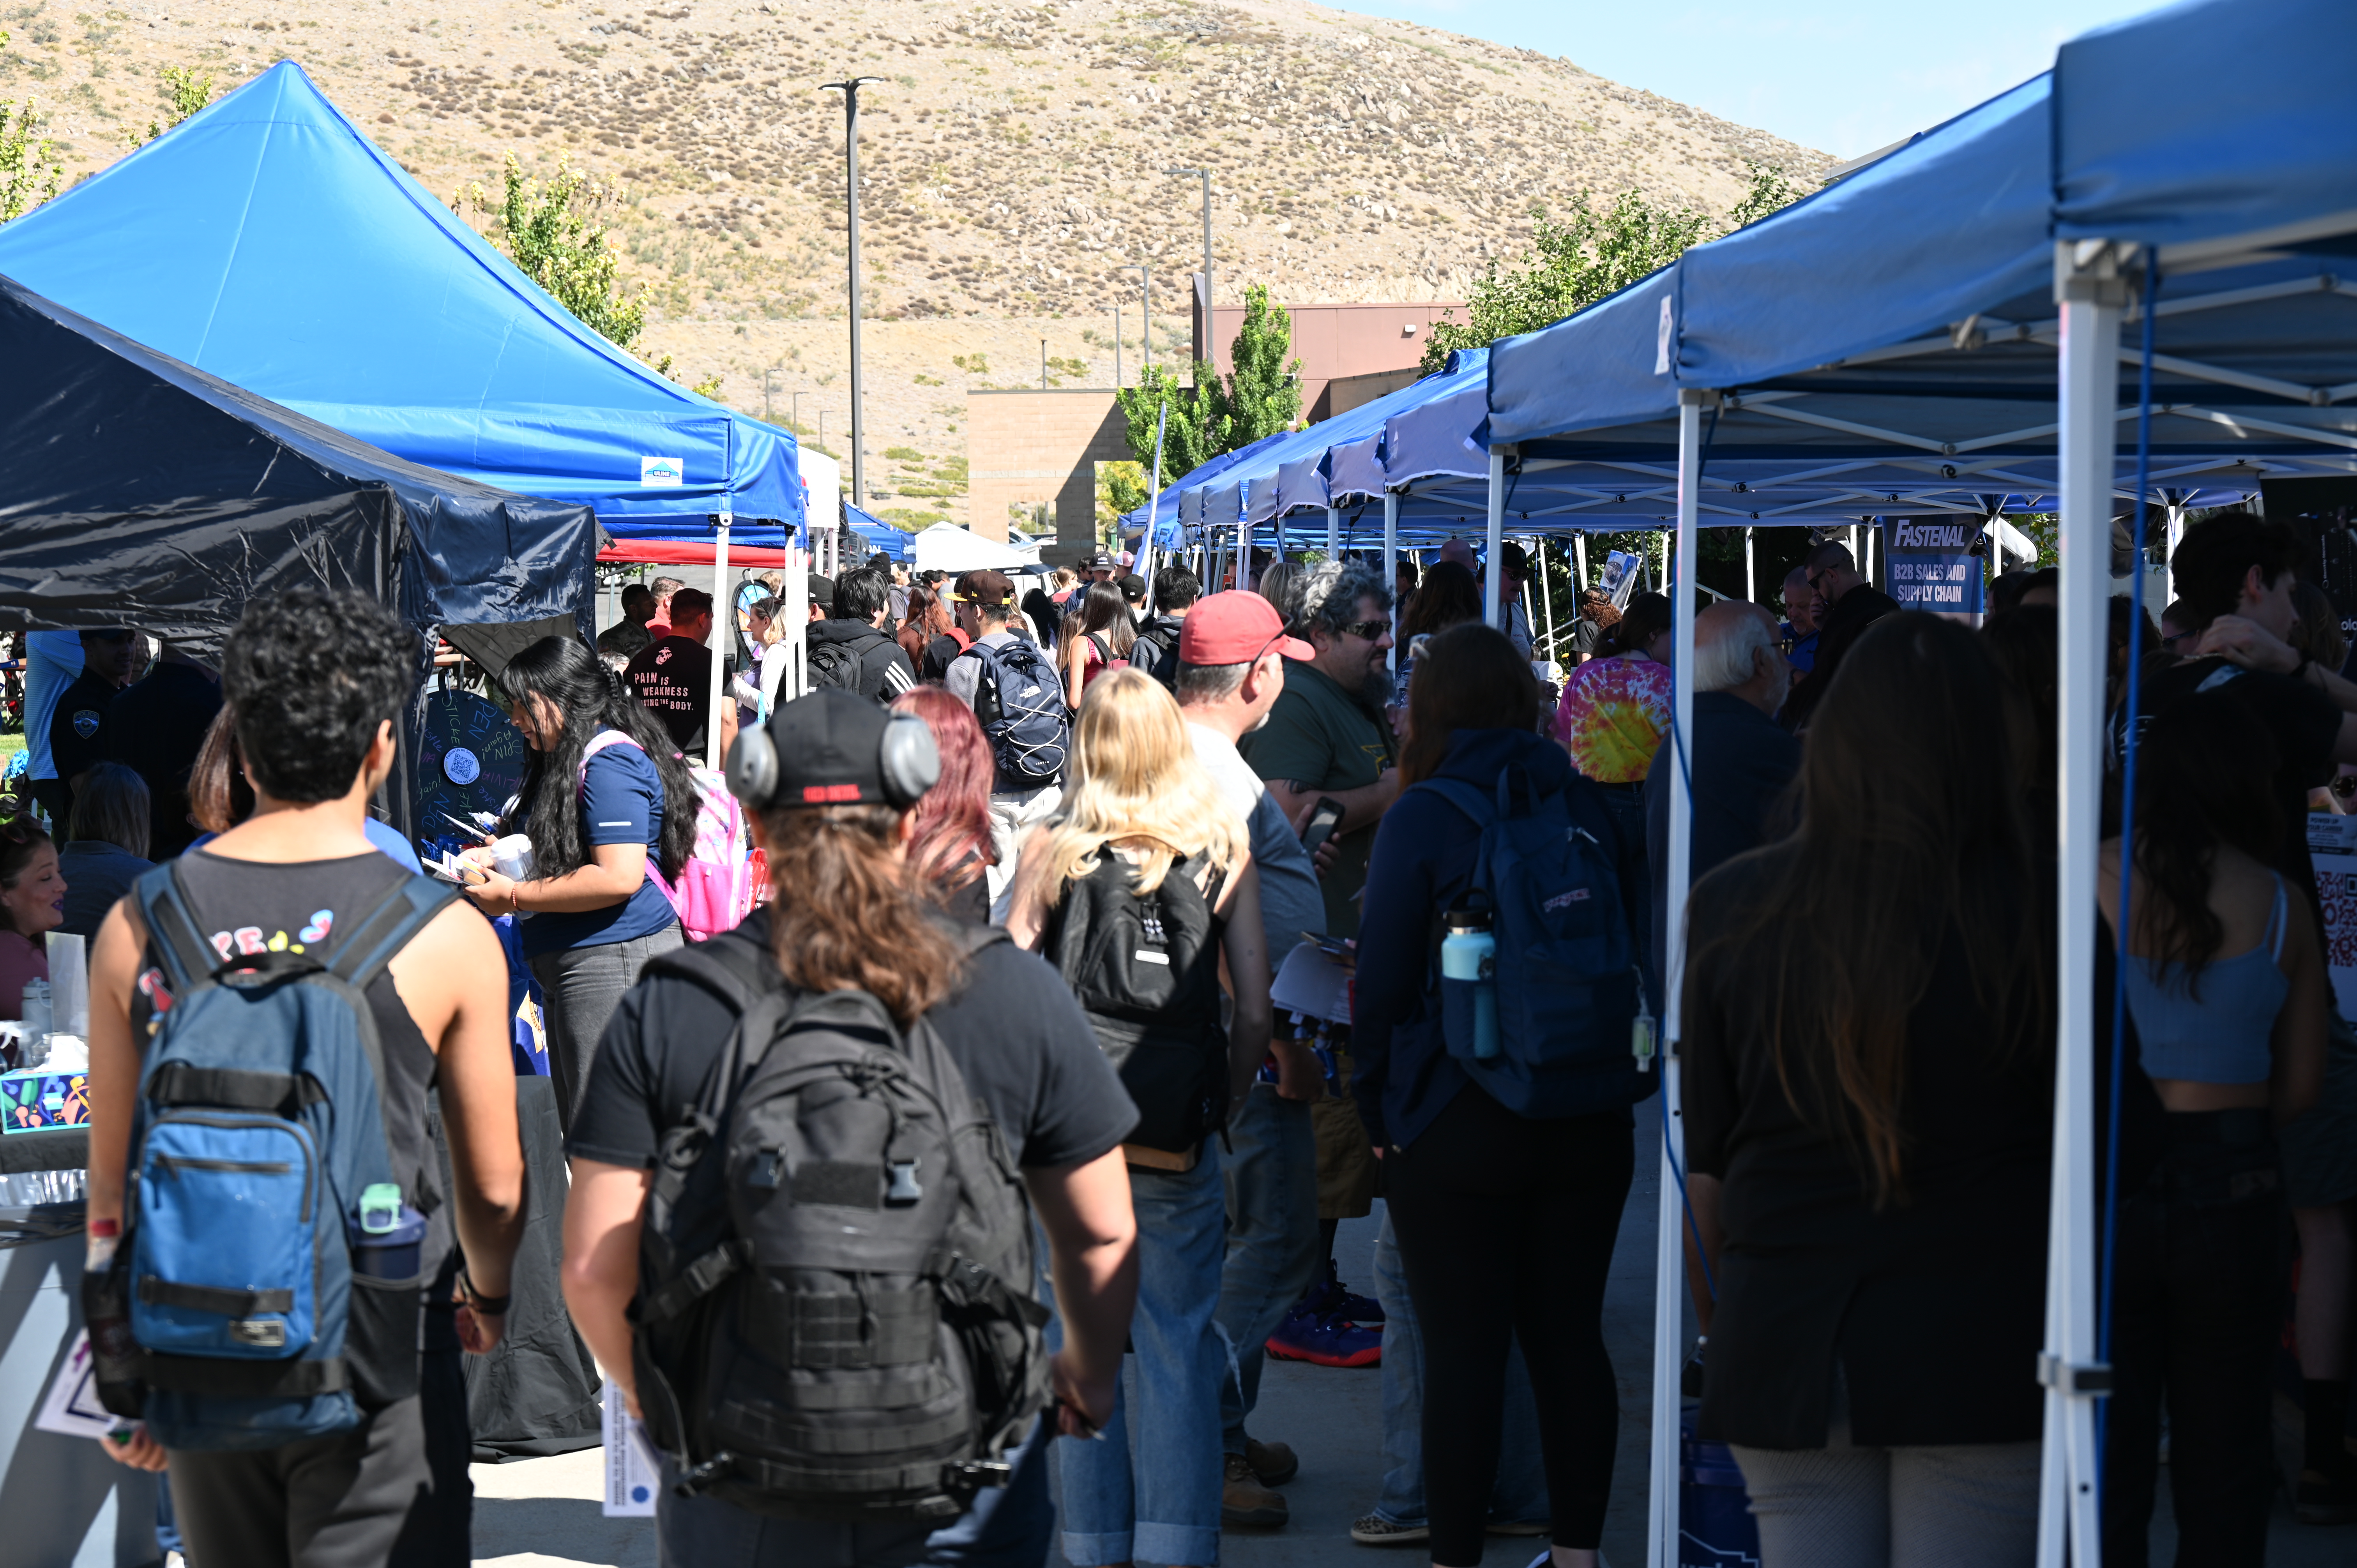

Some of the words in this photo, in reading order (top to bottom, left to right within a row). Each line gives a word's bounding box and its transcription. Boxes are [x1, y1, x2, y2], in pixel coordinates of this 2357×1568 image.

[1894, 519, 1965, 547] FASTENAL
[1894, 564, 1914, 580] B2B
[1916, 564, 1944, 580] SALES
[1945, 564, 1966, 581] AND
[1898, 584, 1933, 601] SUPPLY
[1935, 585, 1962, 602] CHAIN
[634, 672, 657, 684] PAIN
[661, 676, 669, 685] IS
[643, 687, 688, 697] WEAKNESS
[670, 701, 694, 711] BODY.
[442, 696, 460, 747] STICKE
[468, 701, 498, 740] PEN
[446, 750, 455, 759] Follow
[466, 750, 475, 759] Social
[495, 739, 523, 761] SPIN
[448, 773, 458, 782] Social
[468, 773, 478, 782] Follow
[482, 770, 519, 790] RIVIA
